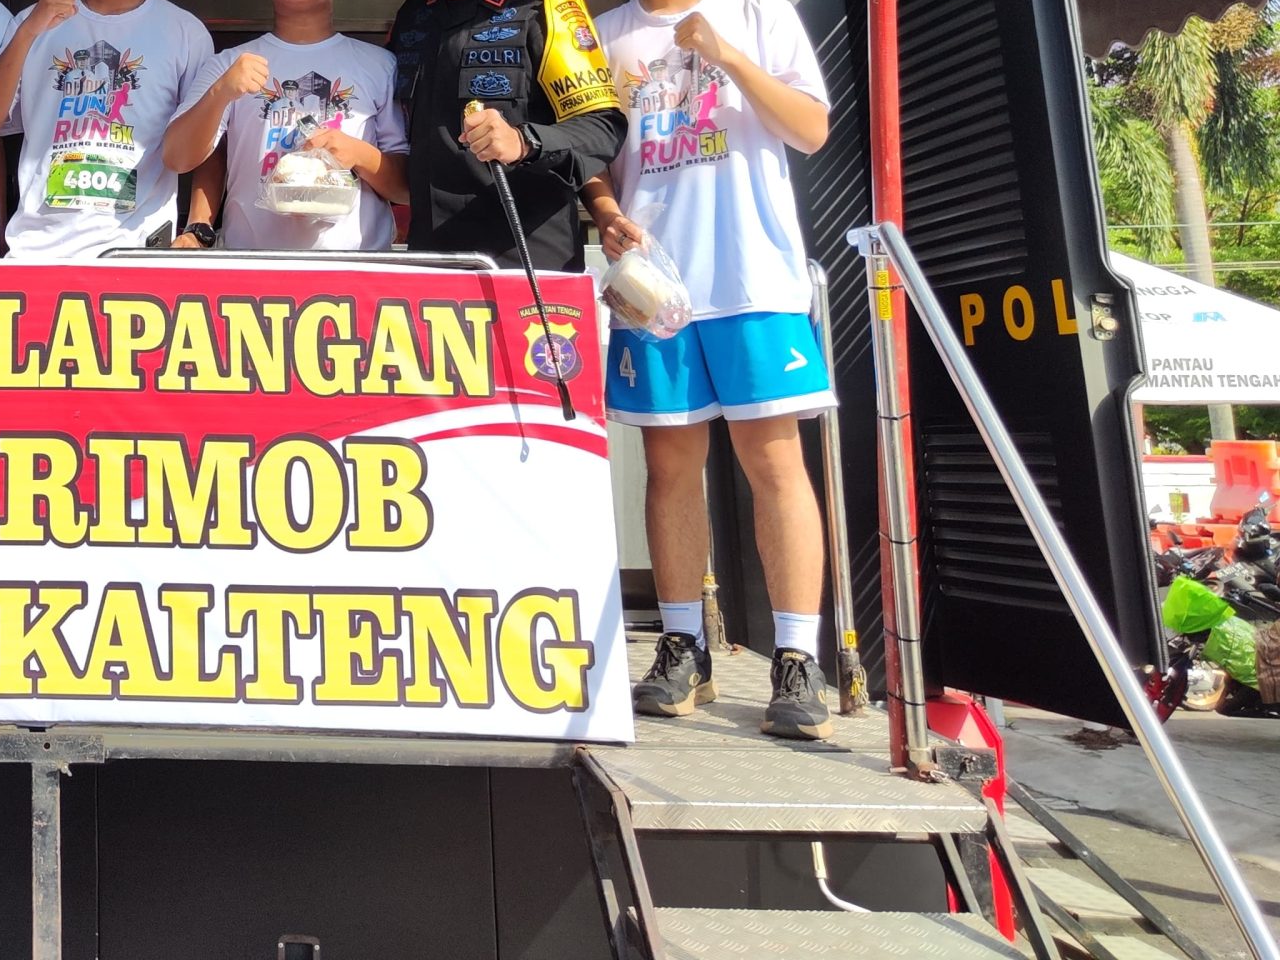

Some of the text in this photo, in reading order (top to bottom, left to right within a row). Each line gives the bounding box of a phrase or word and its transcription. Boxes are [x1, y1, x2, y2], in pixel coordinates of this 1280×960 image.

[468, 48, 520, 64] POLRI
[58, 94, 107, 118] FUN
[559, 95, 584, 113] OPERASI
[53, 118, 134, 145] RUN 5K
[640, 110, 690, 139] FUN
[52, 141, 135, 151] KALTENG BERKAH
[266, 127, 299, 149] FU
[640, 128, 729, 168] RUN 5K
[686, 153, 730, 166] BERKAH
[63, 170, 122, 192] 4804
[1134, 285, 1197, 296] NGGA
[520, 305, 581, 318] KALIMTAN TENGAH
[960, 278, 1079, 346] POL
[619, 346, 637, 387] 4
[1151, 358, 1214, 372] PANTAU
